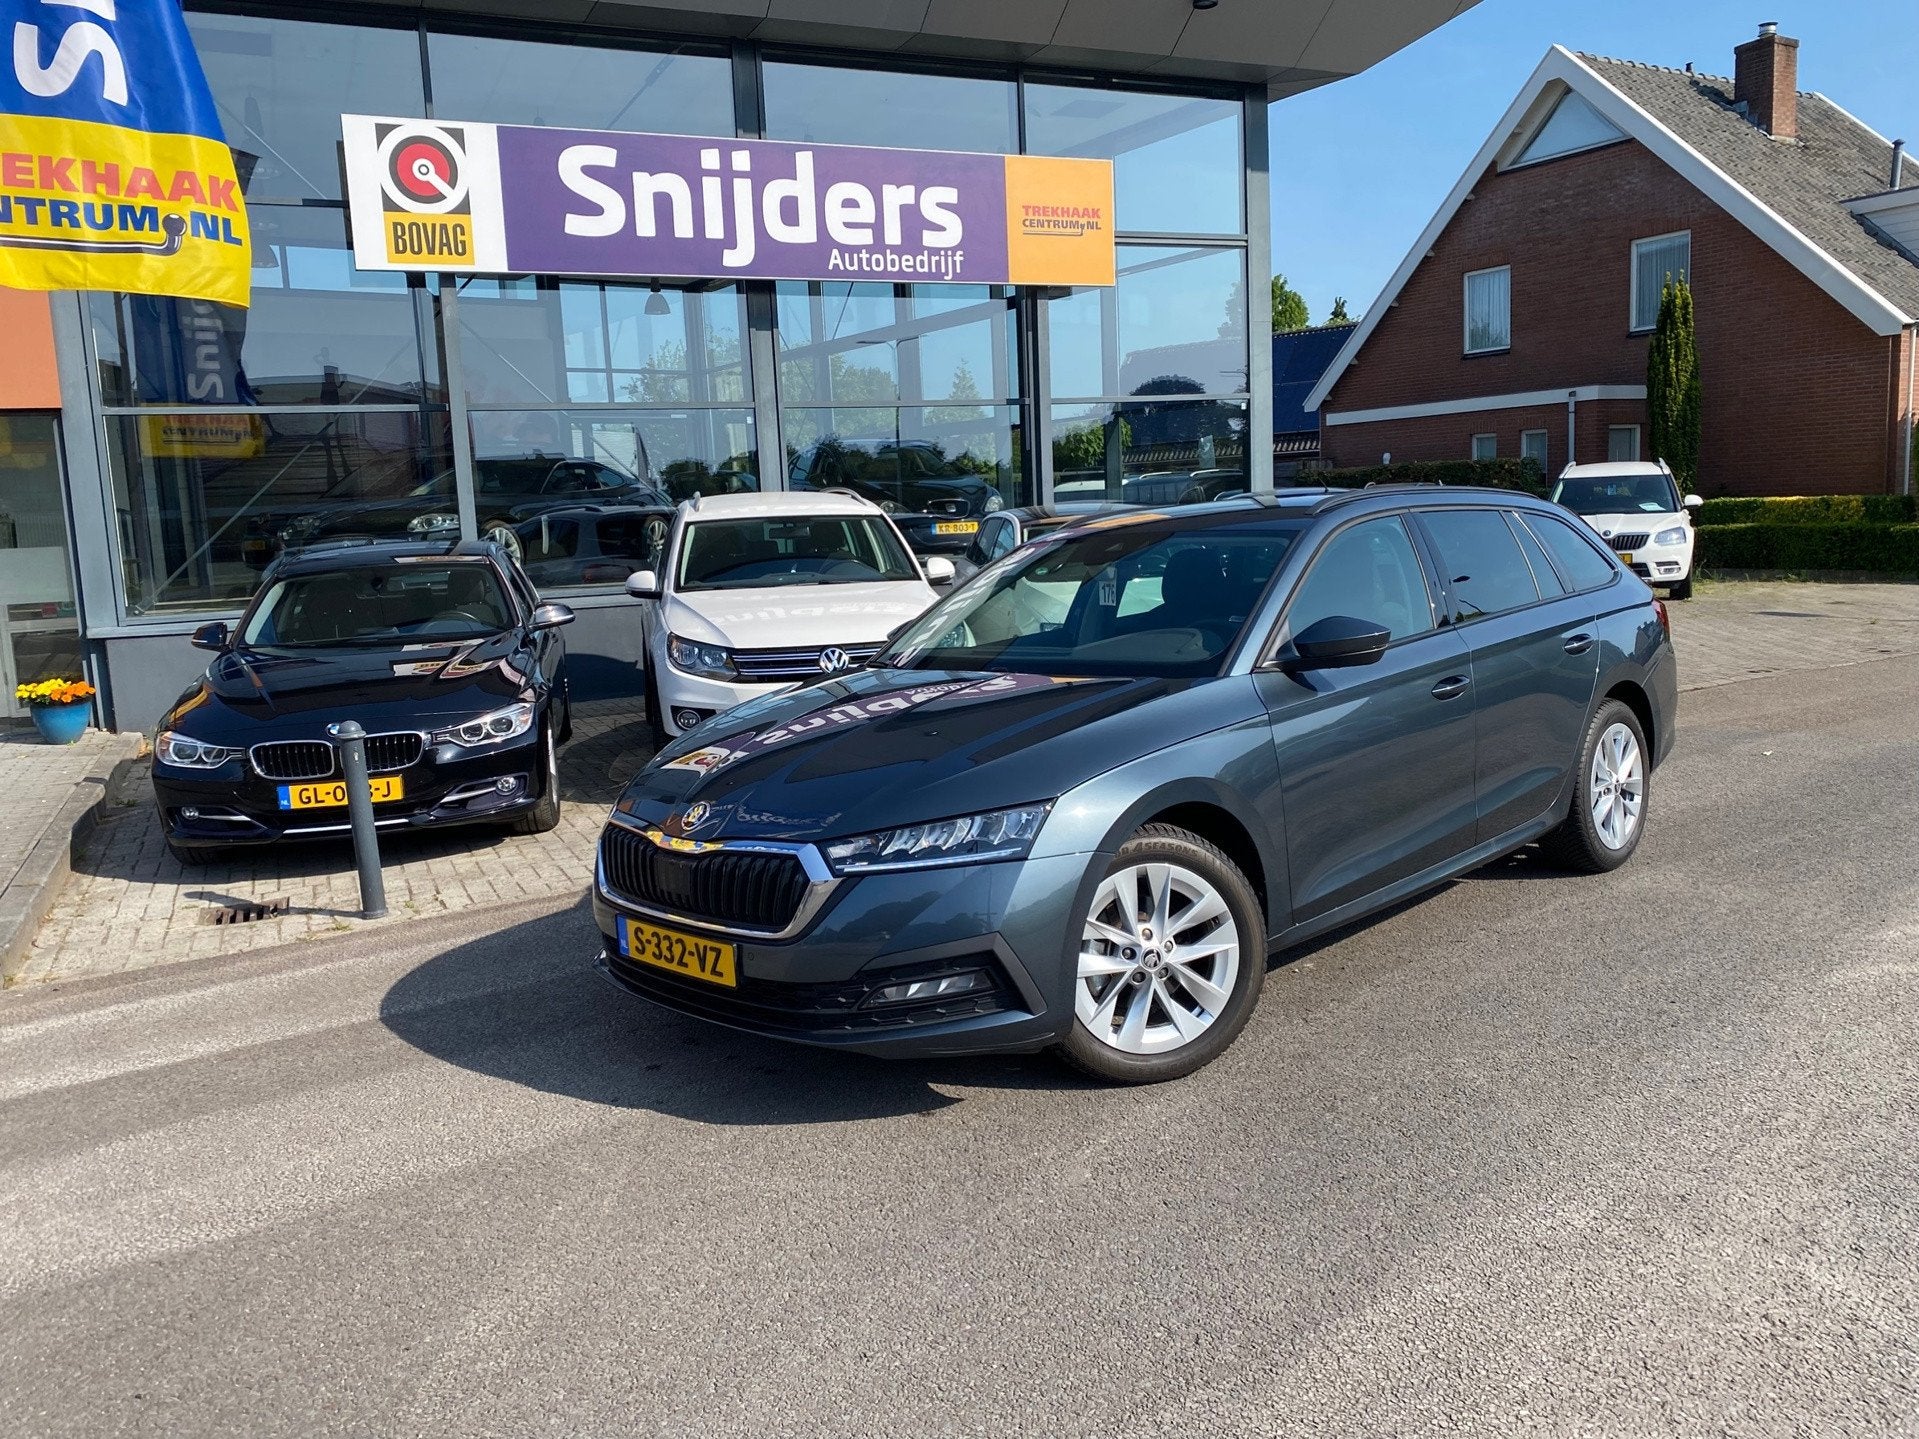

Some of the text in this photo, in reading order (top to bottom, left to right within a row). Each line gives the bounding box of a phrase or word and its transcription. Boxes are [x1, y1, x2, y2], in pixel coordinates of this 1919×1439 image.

[13, 0, 129, 107] S
[556, 144, 964, 268] Snijders
[1022, 205, 1101, 219] TREKHAAK
[392, 221, 467, 257] BOVAG
[828, 248, 964, 281] Autobedrijf
[298, 780, 391, 805] GL-0-J
[633, 926, 724, 978] S-332-VZ
